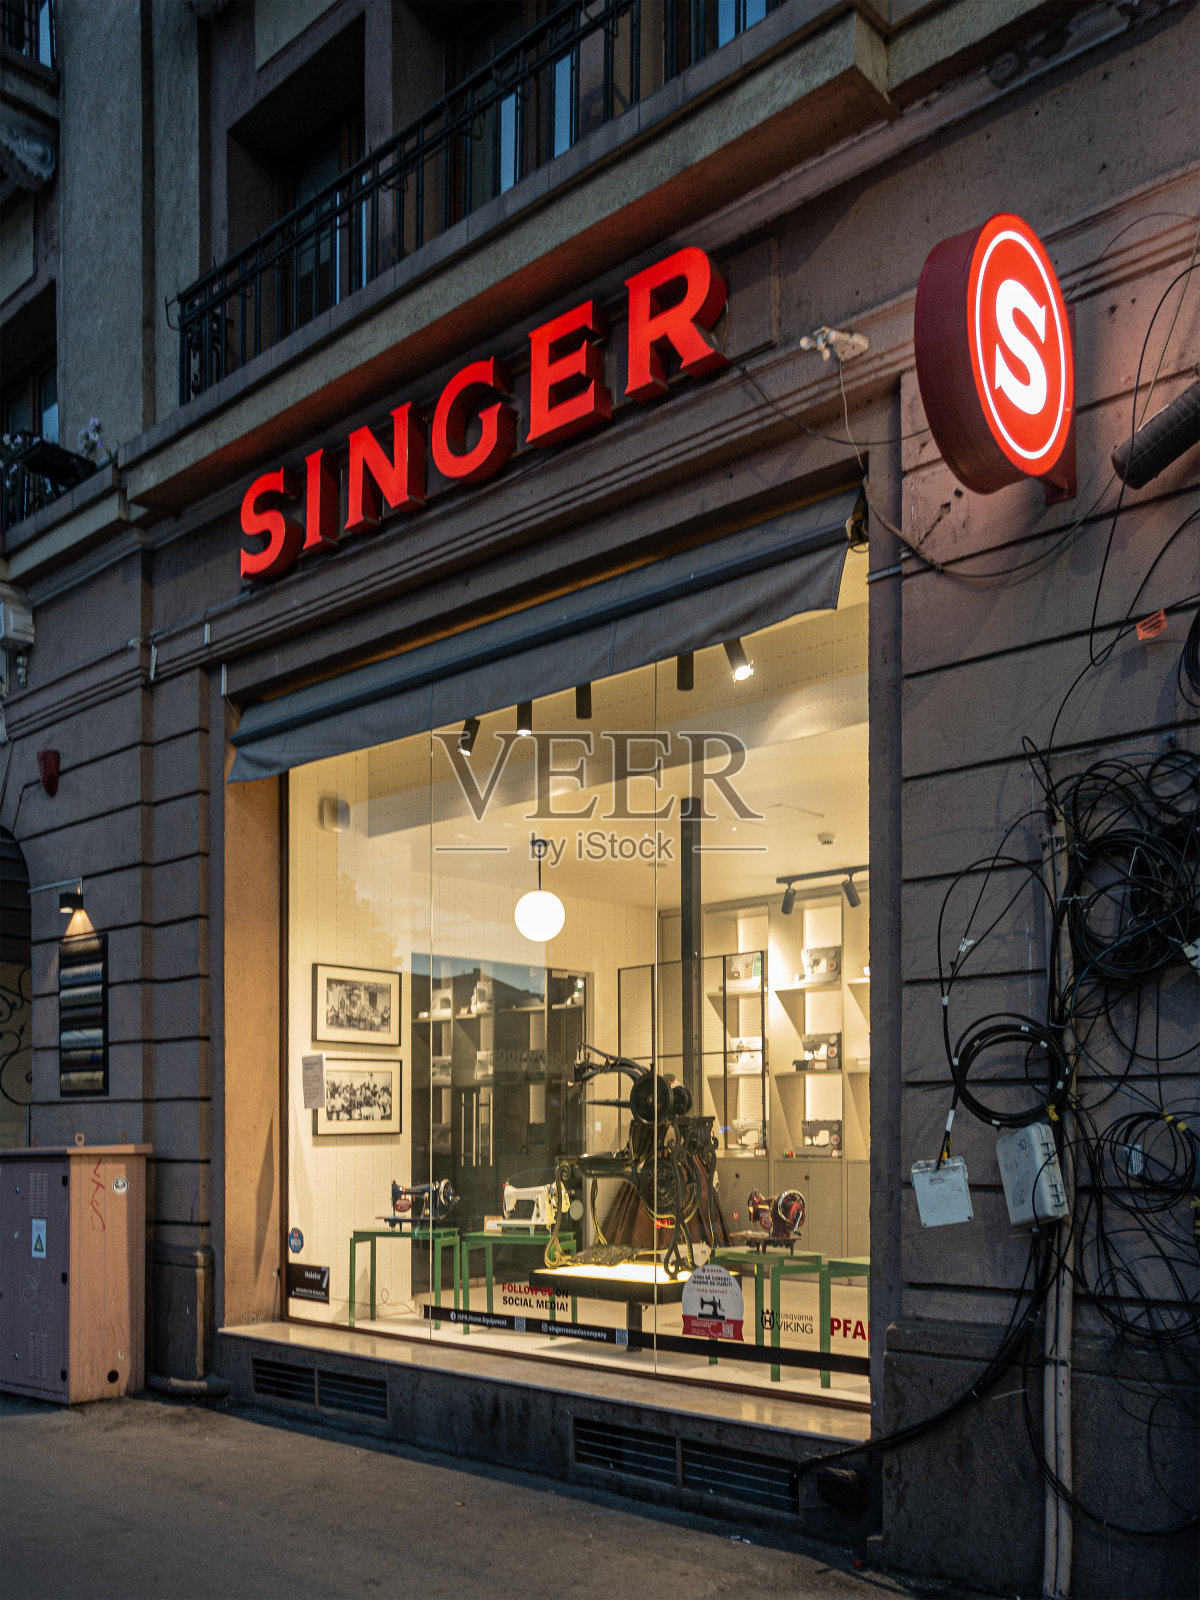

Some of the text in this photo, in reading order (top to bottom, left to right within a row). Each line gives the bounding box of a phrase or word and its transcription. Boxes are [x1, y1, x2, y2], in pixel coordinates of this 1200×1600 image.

[995, 279, 1047, 415] S
[240, 246, 730, 580] SINGER
[502, 1282, 569, 1299] FOLLOW US ON
[502, 1295, 569, 1312] SOCIAL MEDIA!
[775, 1310, 814, 1322] Husqvarna
[775, 1320, 814, 1334] VIKING
[830, 1317, 870, 1341] PFA
